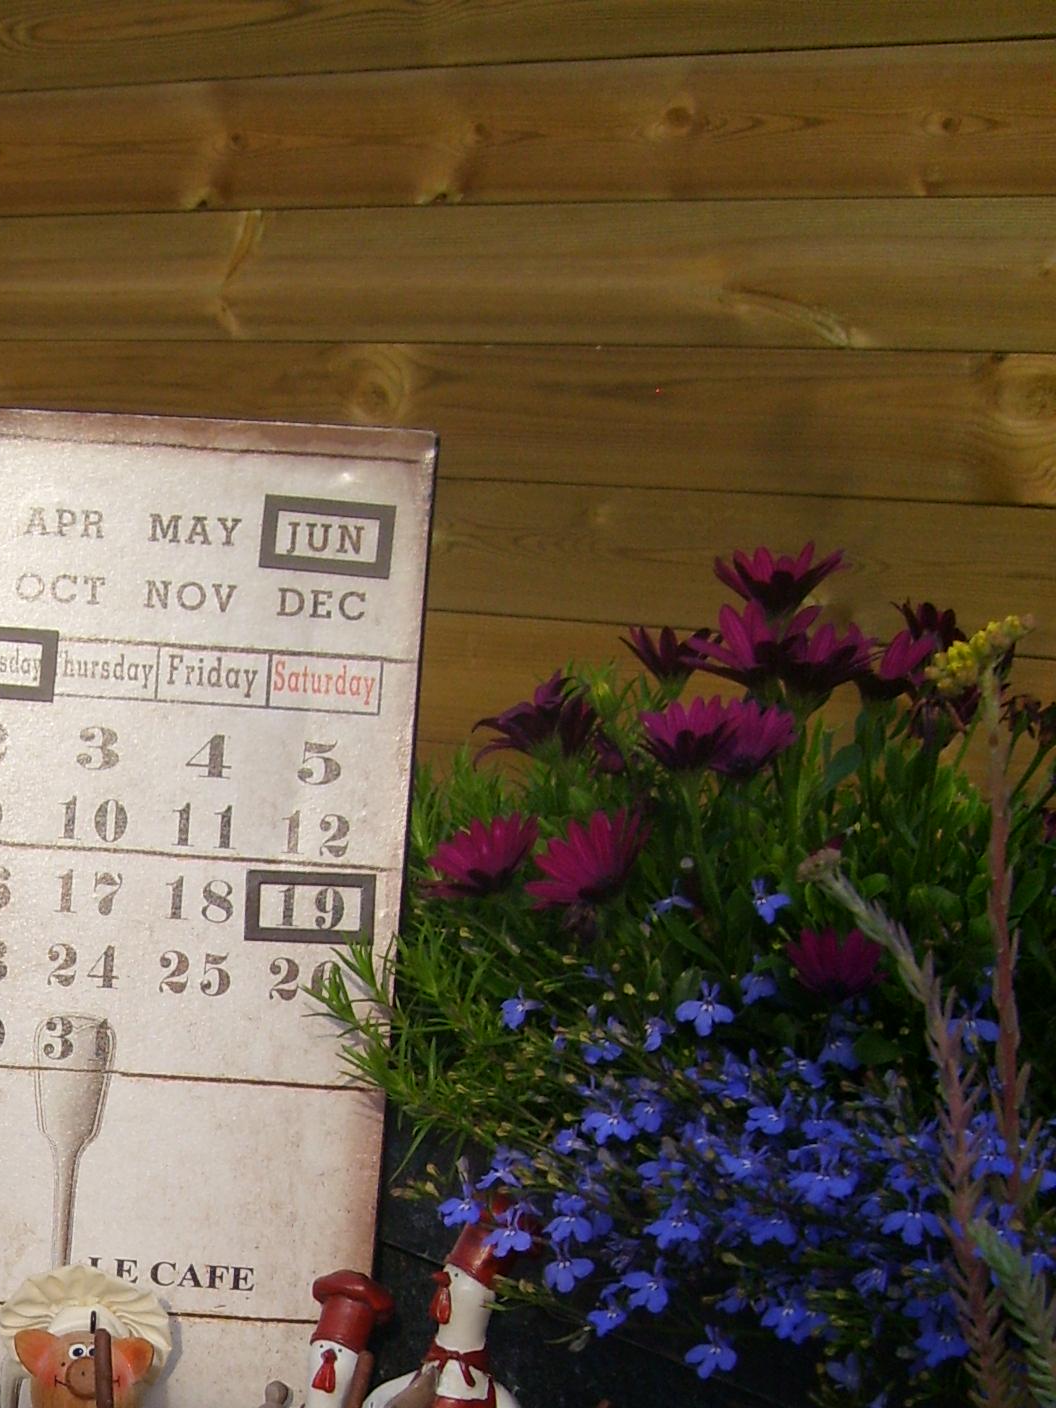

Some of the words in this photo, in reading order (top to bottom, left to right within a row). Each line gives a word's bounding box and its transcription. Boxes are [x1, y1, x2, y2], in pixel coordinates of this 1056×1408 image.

[24, 507, 105, 538] APR
[148, 513, 242, 546] MAY
[287, 521, 366, 555] JUN
[15, 573, 106, 606] OCT
[144, 580, 238, 612] NOV
[276, 587, 366, 620] DEC
[167, 653, 259, 698] Friday
[273, 660, 376, 705] Saturday
[76, 726, 120, 770] 3
[185, 734, 232, 779] 4
[297, 740, 341, 786] 5
[59, 795, 128, 842] 10
[172, 802, 236, 850] 11
[282, 810, 351, 858] 12
[54, 868, 123, 916] 17
[165, 875, 233, 924] 18
[278, 885, 345, 930] 19
[47, 943, 120, 989] 24
[159, 950, 231, 996] 25
[149, 1261, 256, 1292] CAFE
